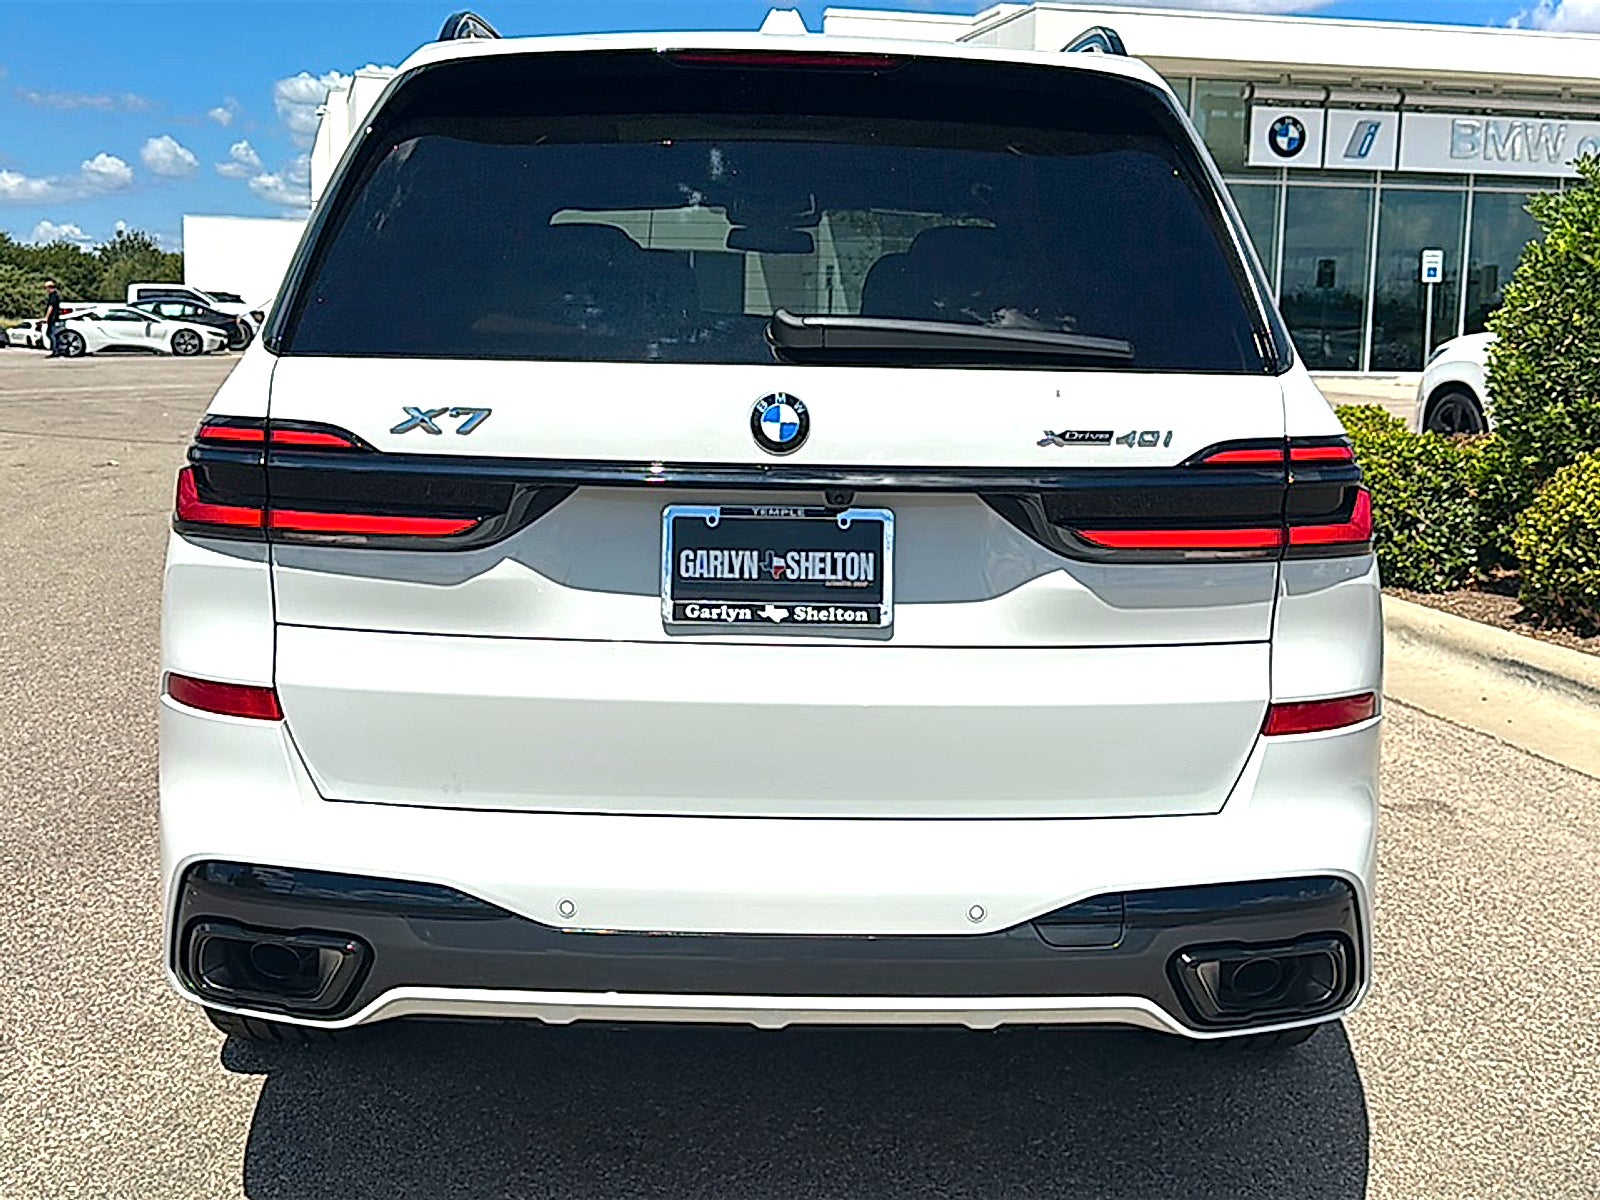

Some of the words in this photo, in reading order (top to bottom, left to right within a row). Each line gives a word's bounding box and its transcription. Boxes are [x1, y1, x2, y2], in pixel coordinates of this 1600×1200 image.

[1450, 119, 1568, 162] BMW
[390, 406, 492, 435] X7
[680, 550, 758, 579] GARLYN
[785, 551, 875, 581] SHELTON
[685, 604, 752, 623] Garlyn
[793, 606, 868, 622] Shelton
